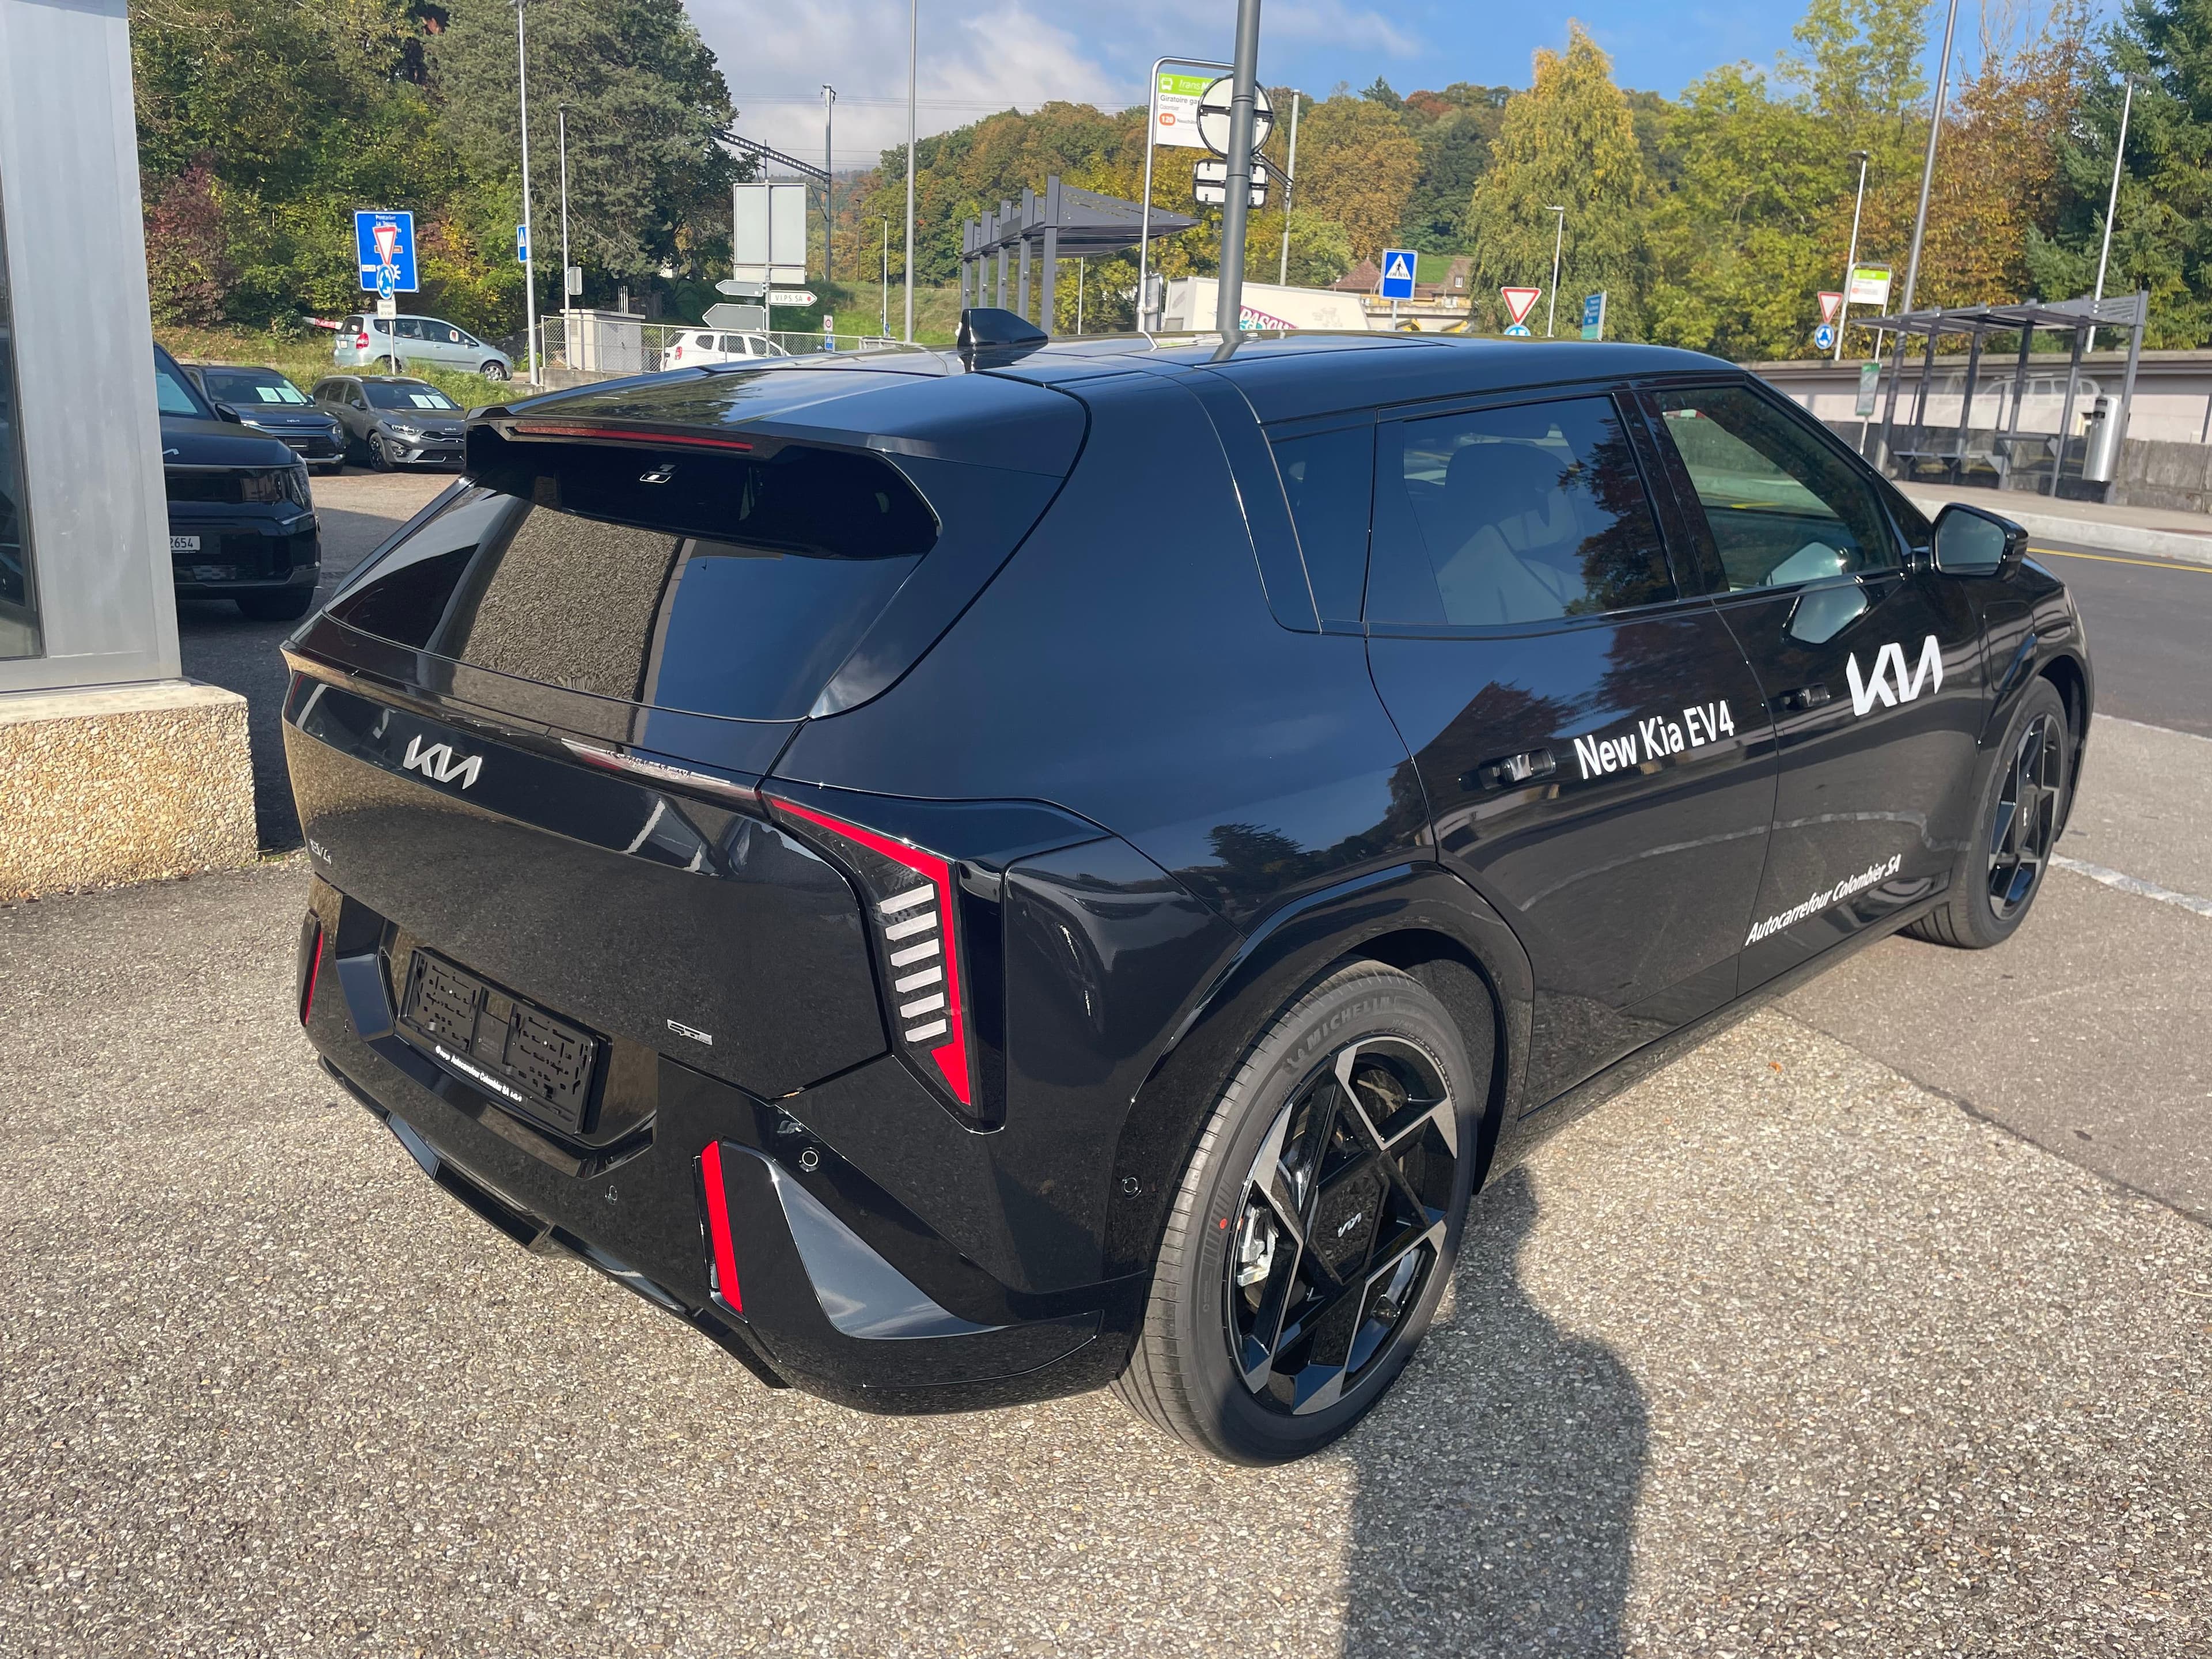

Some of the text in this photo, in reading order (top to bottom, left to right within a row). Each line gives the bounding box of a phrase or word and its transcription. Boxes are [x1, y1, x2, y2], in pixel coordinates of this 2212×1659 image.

[1160, 94, 1188, 103] Giratoire
[1846, 635, 1944, 716] KIA
[403, 734, 483, 790] KIA
[1574, 700, 1734, 779] New Kia EV4
[309, 838, 332, 865] EV4
[1745, 853, 1902, 946] Autocarrefour Colombier SA
